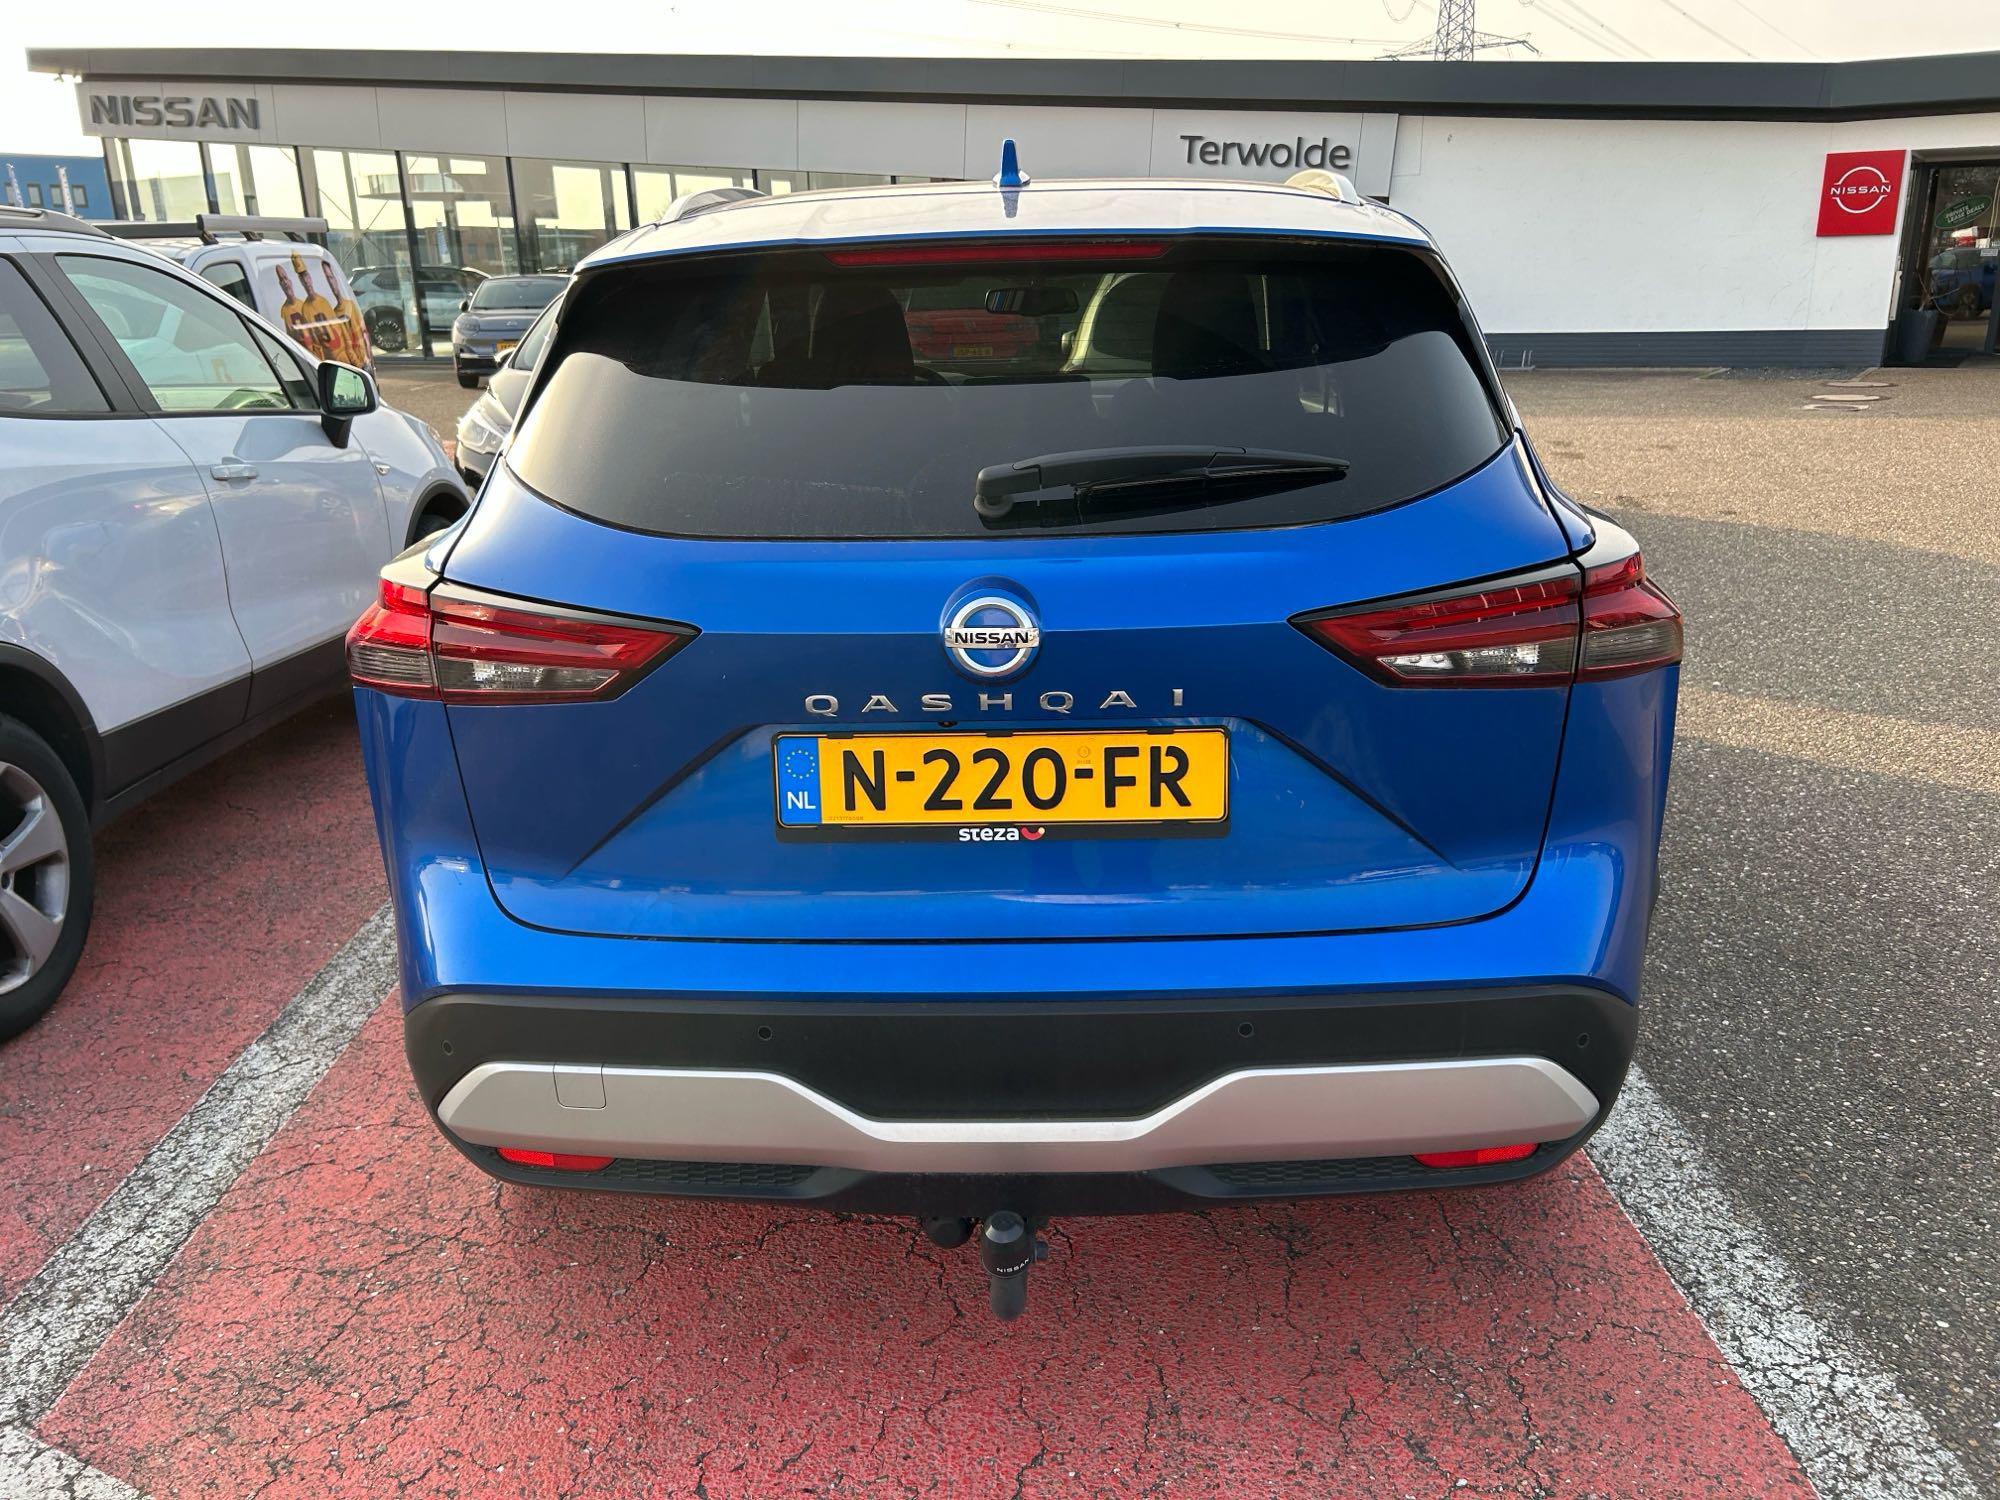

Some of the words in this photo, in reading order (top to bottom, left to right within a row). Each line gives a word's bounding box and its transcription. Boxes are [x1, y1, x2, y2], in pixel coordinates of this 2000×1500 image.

[89, 95, 260, 130] NISSAN
[1180, 135, 1351, 169] Terwolde
[1830, 185, 1892, 195] NISSAN
[1945, 205, 1970, 218] PRIVATE
[1947, 212, 1966, 223] LEASE
[1966, 203, 1985, 215] DEALS
[954, 632, 1029, 644] NISSAN
[804, 688, 1184, 717] QASHQAI
[842, 745, 1192, 811] N-220-FR
[787, 791, 816, 809] NL
[958, 827, 1020, 842] steza
[997, 1257, 1030, 1273] NISSAN
